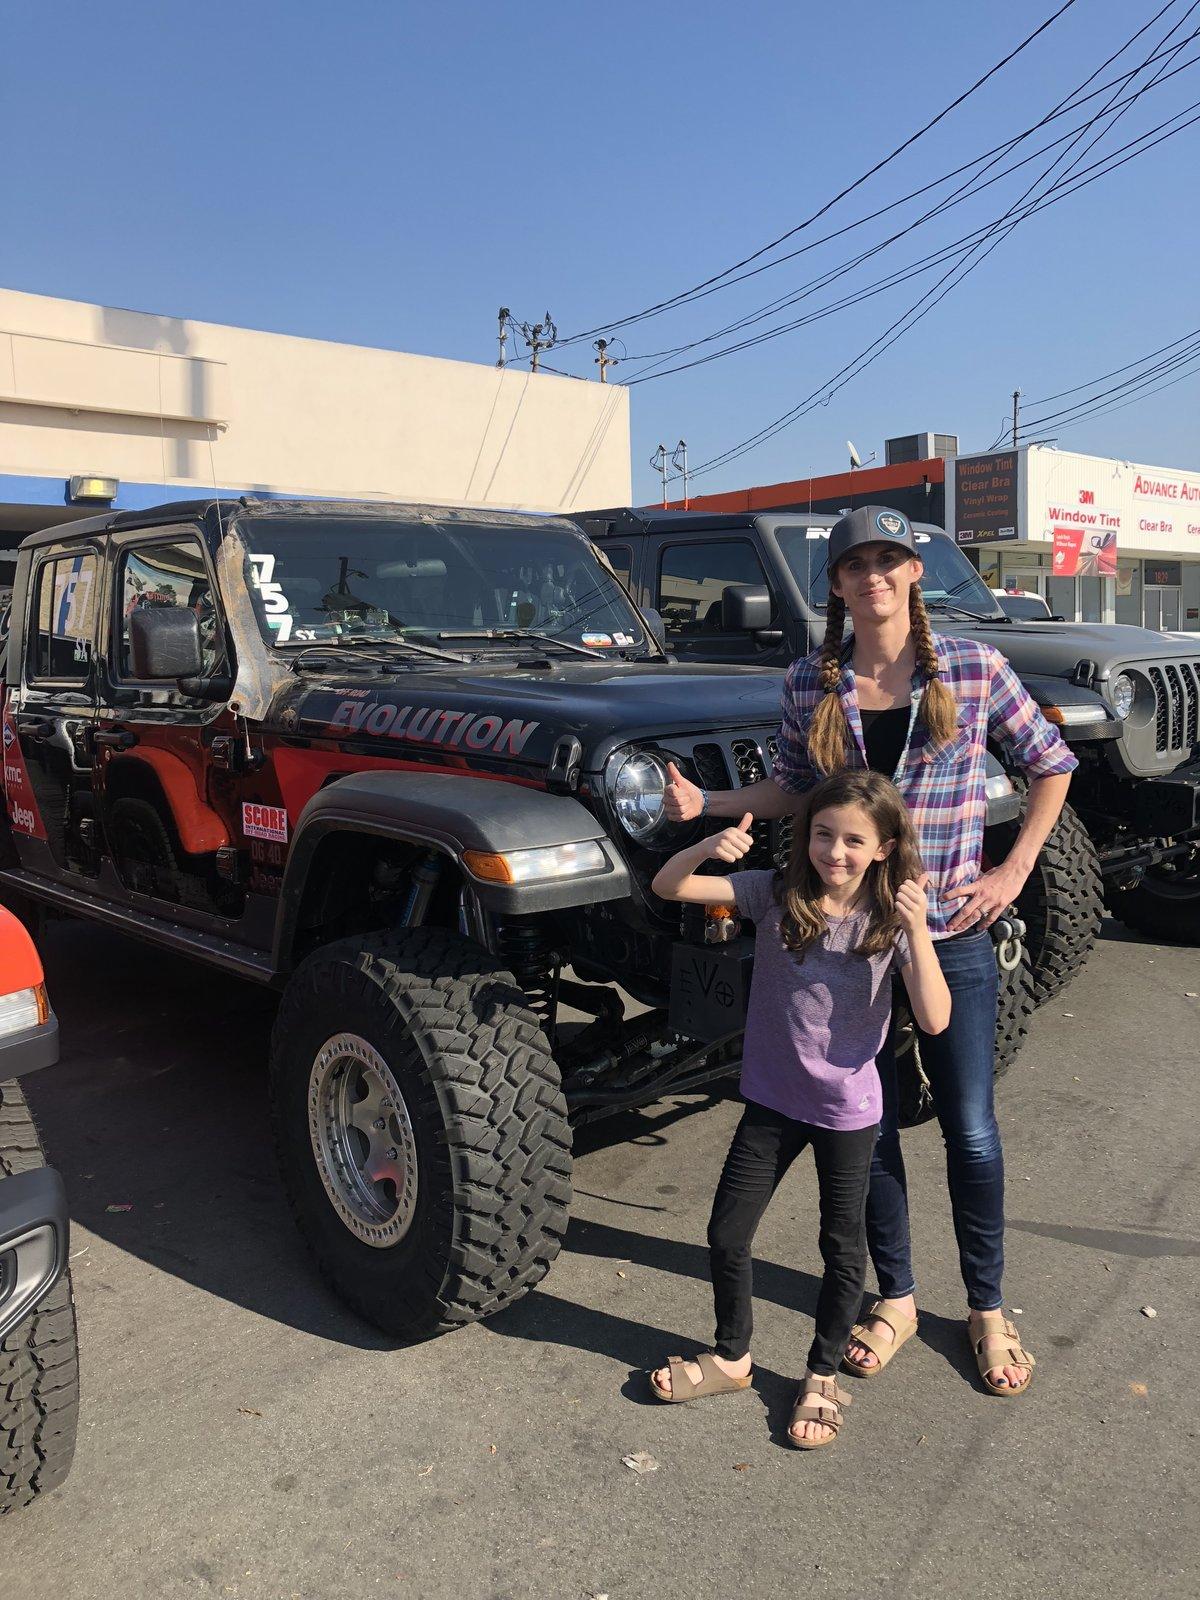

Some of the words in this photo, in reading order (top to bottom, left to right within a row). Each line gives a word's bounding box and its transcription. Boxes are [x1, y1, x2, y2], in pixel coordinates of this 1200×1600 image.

[959, 462, 993, 475] Window
[995, 457, 1014, 471] Tint
[961, 480, 989, 491] Clear
[992, 477, 1010, 488] Bra
[1134, 475, 1177, 498] ADVANCE
[963, 496, 984, 506] Vinyl
[986, 494, 1009, 504] Wrap
[1079, 490, 1094, 504] 3M
[1049, 507, 1097, 524] Window
[1099, 513, 1121, 527] Tint
[977, 529, 995, 538] XPEL
[1140, 519, 1158, 531] Clear
[1160, 520, 1172, 532] Bra
[295, 629, 317, 640] SX
[331, 700, 540, 755] EVOLUTION
[12, 801, 35, 832] Jeep
[244, 804, 285, 831] SCORE
